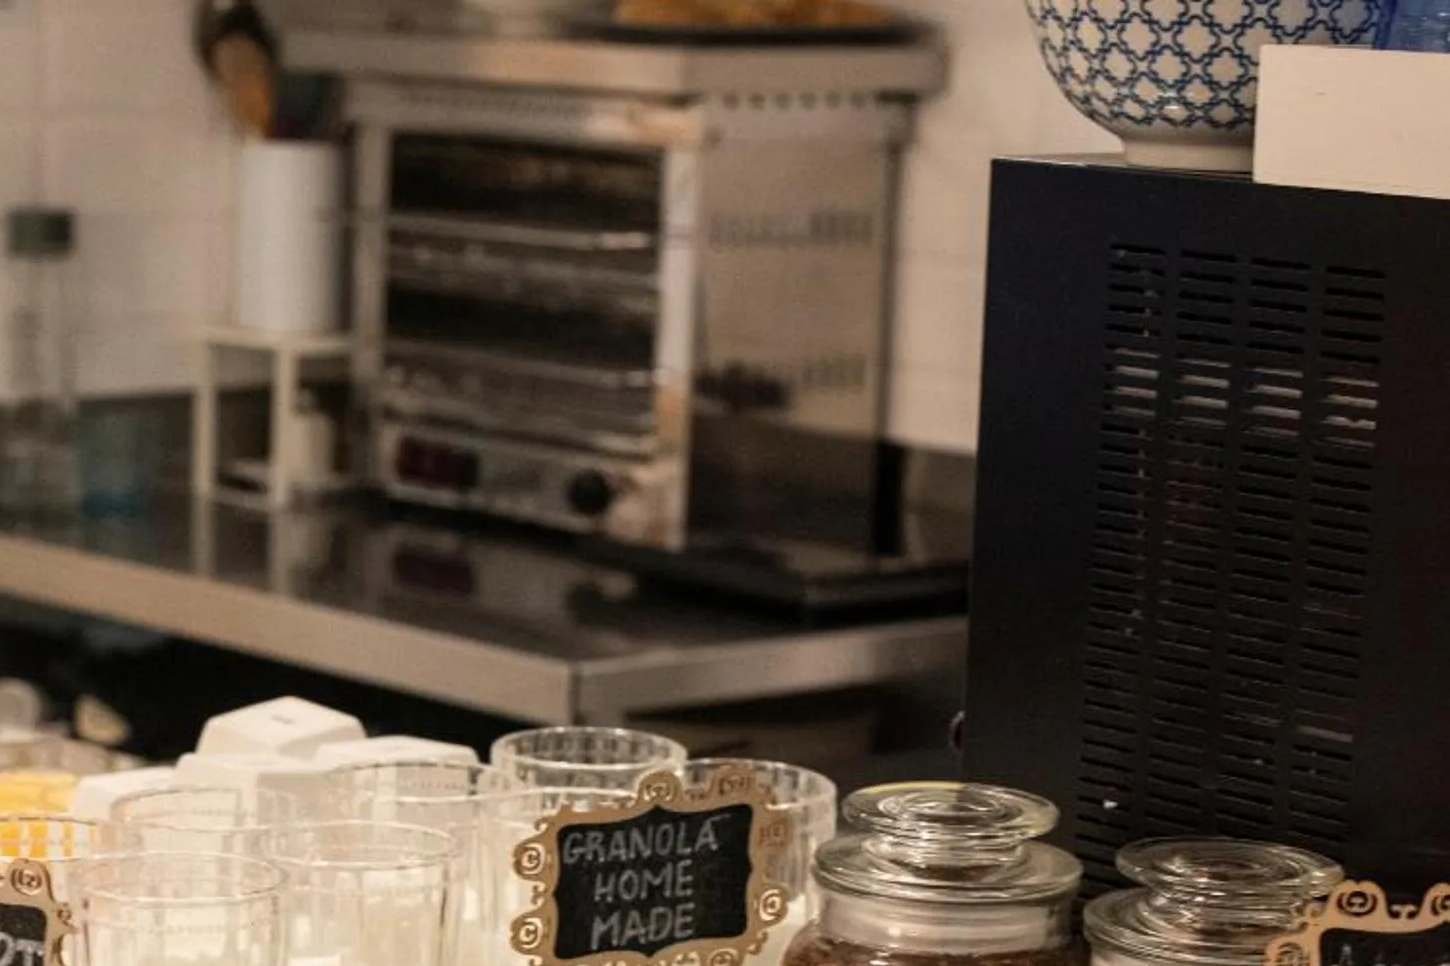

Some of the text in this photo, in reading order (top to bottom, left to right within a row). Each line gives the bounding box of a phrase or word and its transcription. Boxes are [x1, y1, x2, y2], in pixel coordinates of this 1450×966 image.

[563, 813, 726, 865] GRANOLA
[594, 859, 693, 903] HOME
[590, 902, 696, 951] MADE
